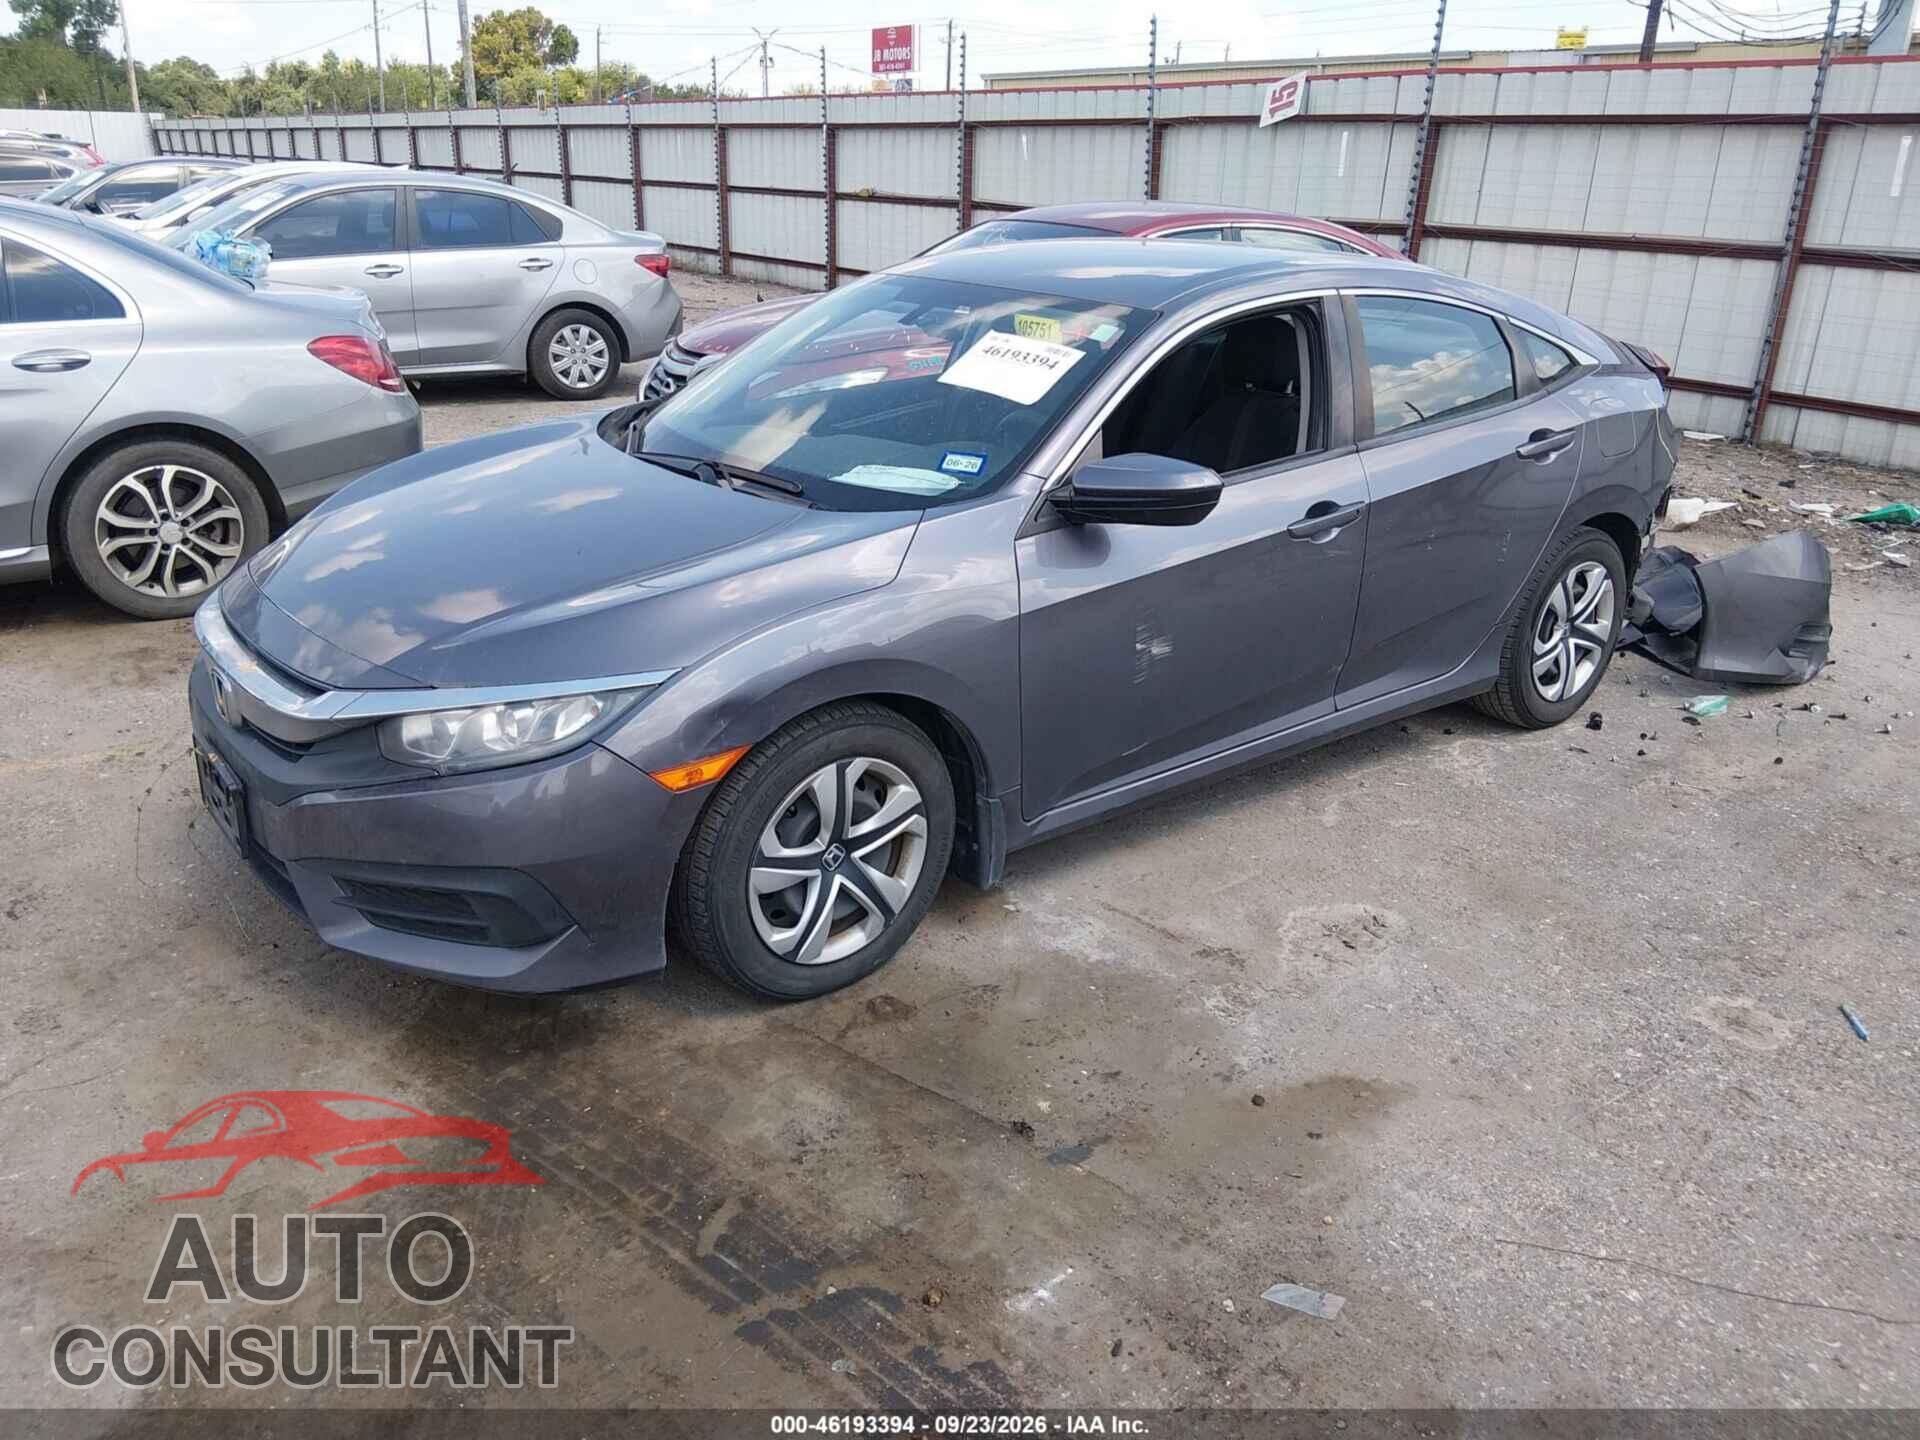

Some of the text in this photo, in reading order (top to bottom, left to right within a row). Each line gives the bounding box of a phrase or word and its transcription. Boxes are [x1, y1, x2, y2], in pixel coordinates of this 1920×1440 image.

[883, 47, 911, 60] MOTORS
[1269, 80, 1298, 119] 15
[982, 344, 1060, 370] 46193394
